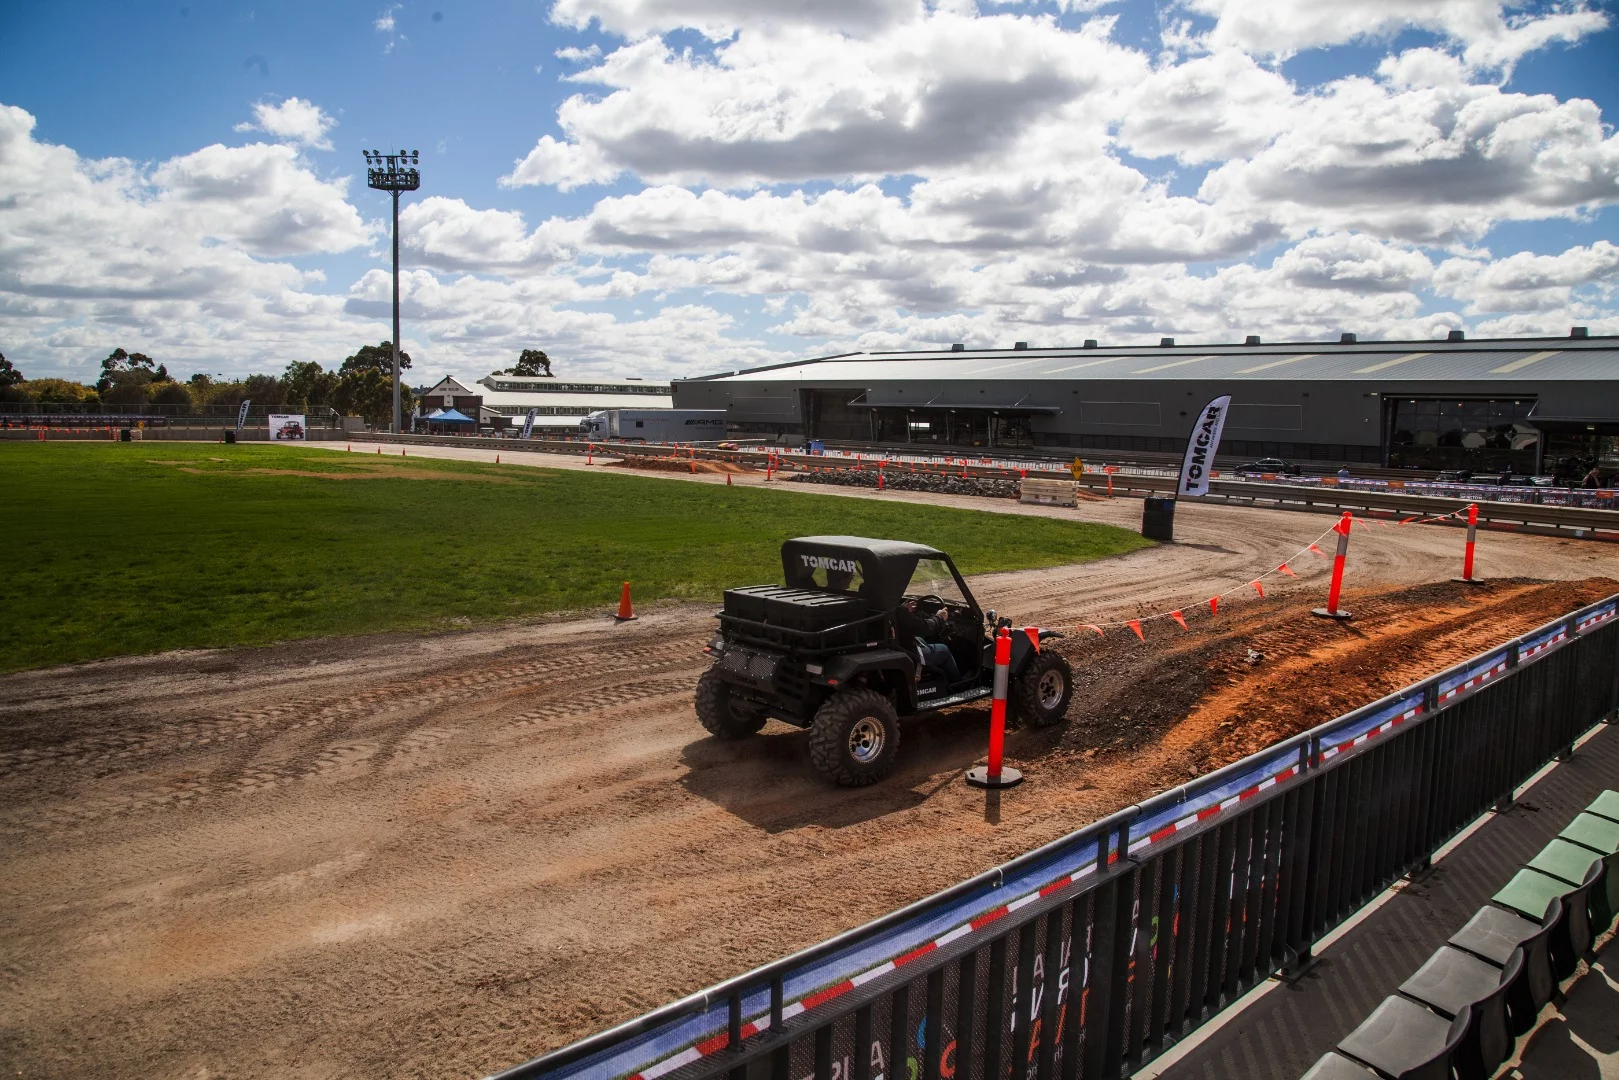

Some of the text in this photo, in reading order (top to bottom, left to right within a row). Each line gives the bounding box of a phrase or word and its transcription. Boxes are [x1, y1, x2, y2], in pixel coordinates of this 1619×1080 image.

[523, 410, 535, 438] TOMCAR
[1185, 405, 1221, 492] TOMCAR
[800, 554, 858, 573] TOMCAR
[916, 686, 937, 696] OMCAR
